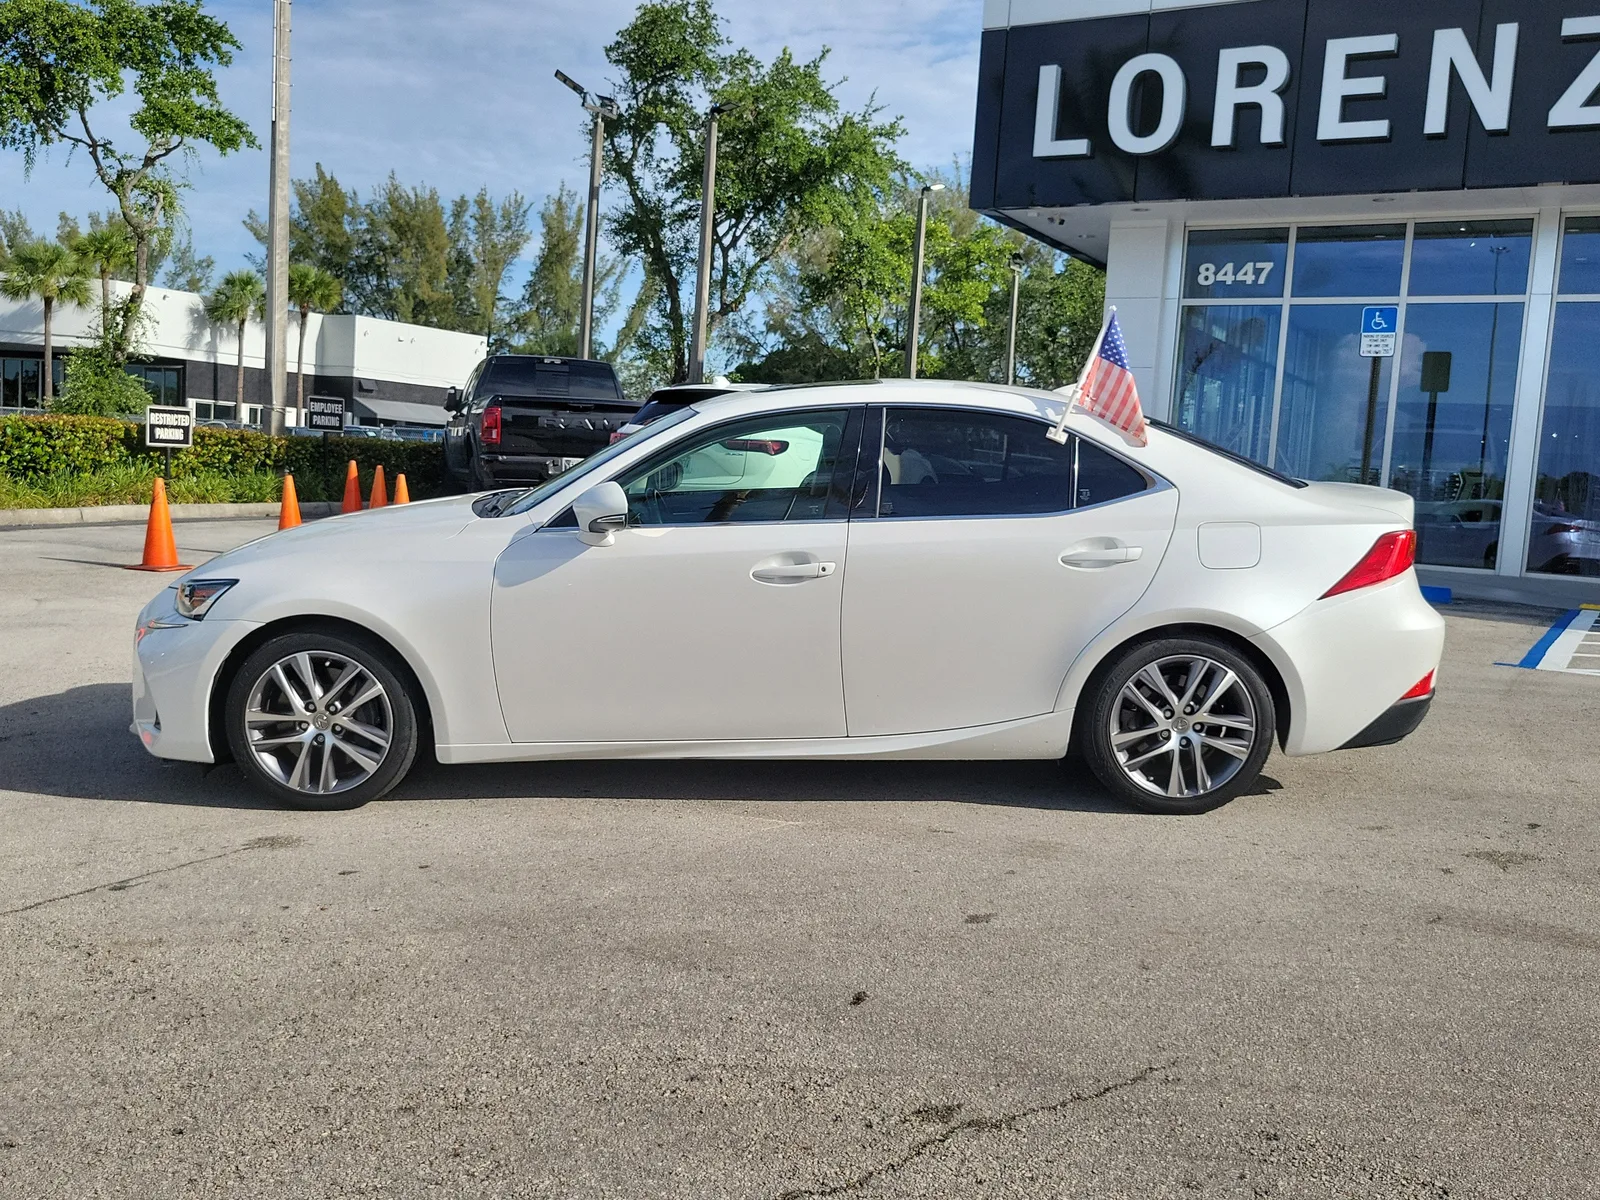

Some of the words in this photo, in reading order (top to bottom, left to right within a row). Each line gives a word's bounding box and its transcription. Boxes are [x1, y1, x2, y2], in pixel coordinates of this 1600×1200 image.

[1197, 261, 1274, 286] 8447
[310, 402, 343, 414] EMPLOYEE
[150, 412, 190, 427] RESTRICTED
[312, 415, 340, 426] PARKING
[538, 416, 621, 431] RAM
[154, 427, 184, 440] PARKING
